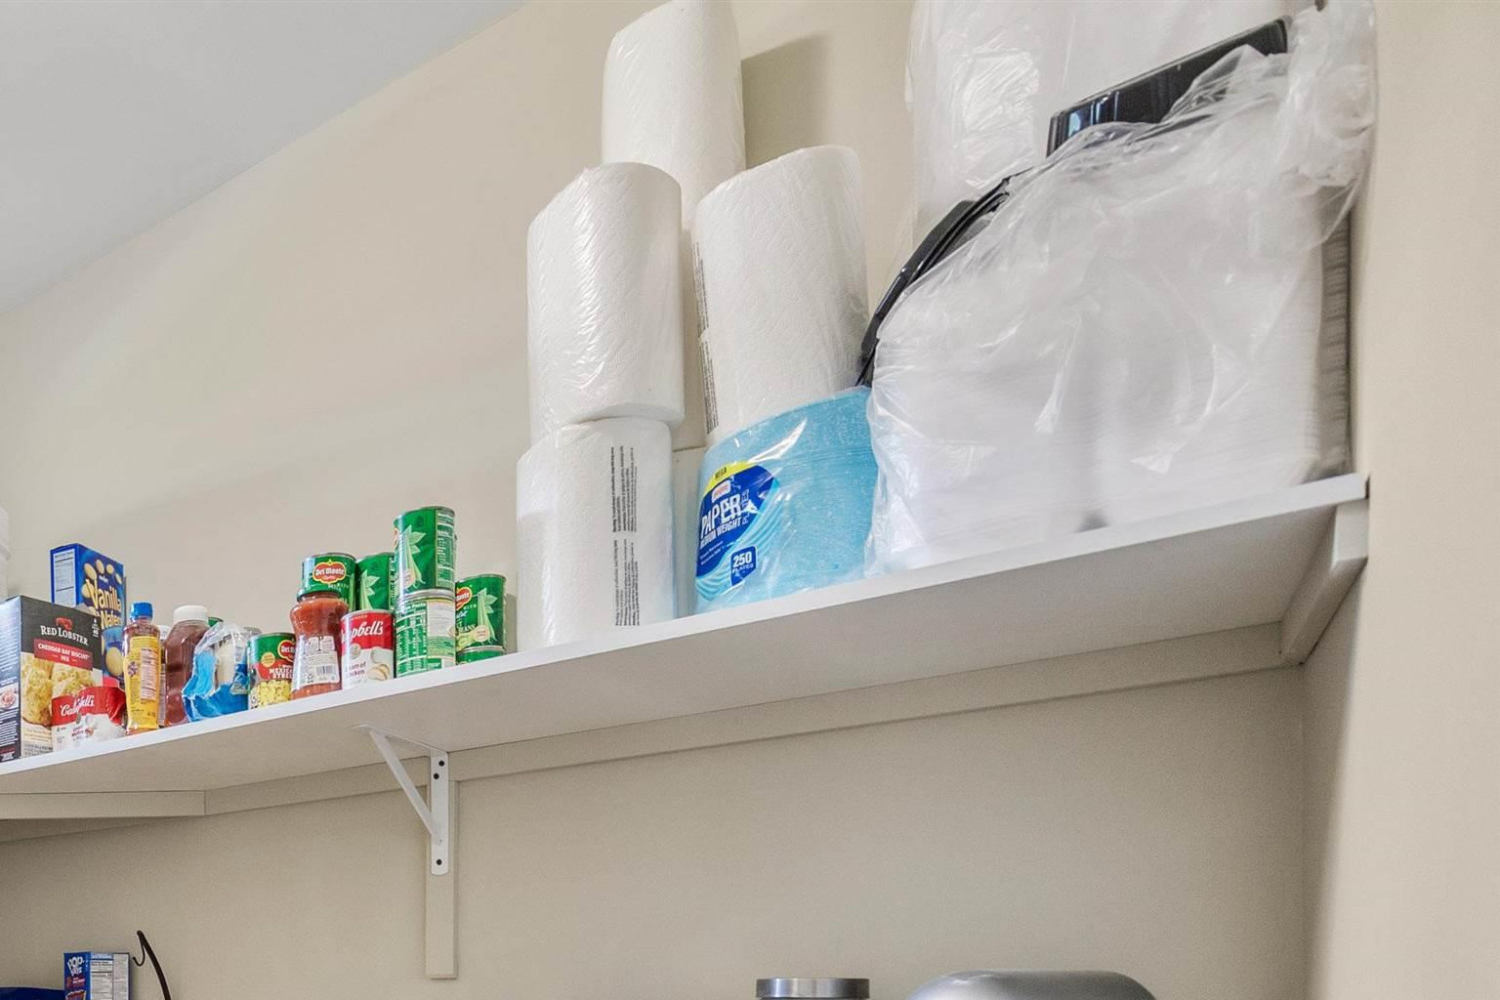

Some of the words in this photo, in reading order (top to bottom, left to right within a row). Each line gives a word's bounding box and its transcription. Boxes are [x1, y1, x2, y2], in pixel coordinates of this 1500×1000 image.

[701, 494, 741, 540] PAPER
[733, 551, 753, 568] 250
[40, 625, 57, 637] RED
[58, 627, 89, 646] LOBSTER
[37, 643, 61, 653] CHEDDAR
